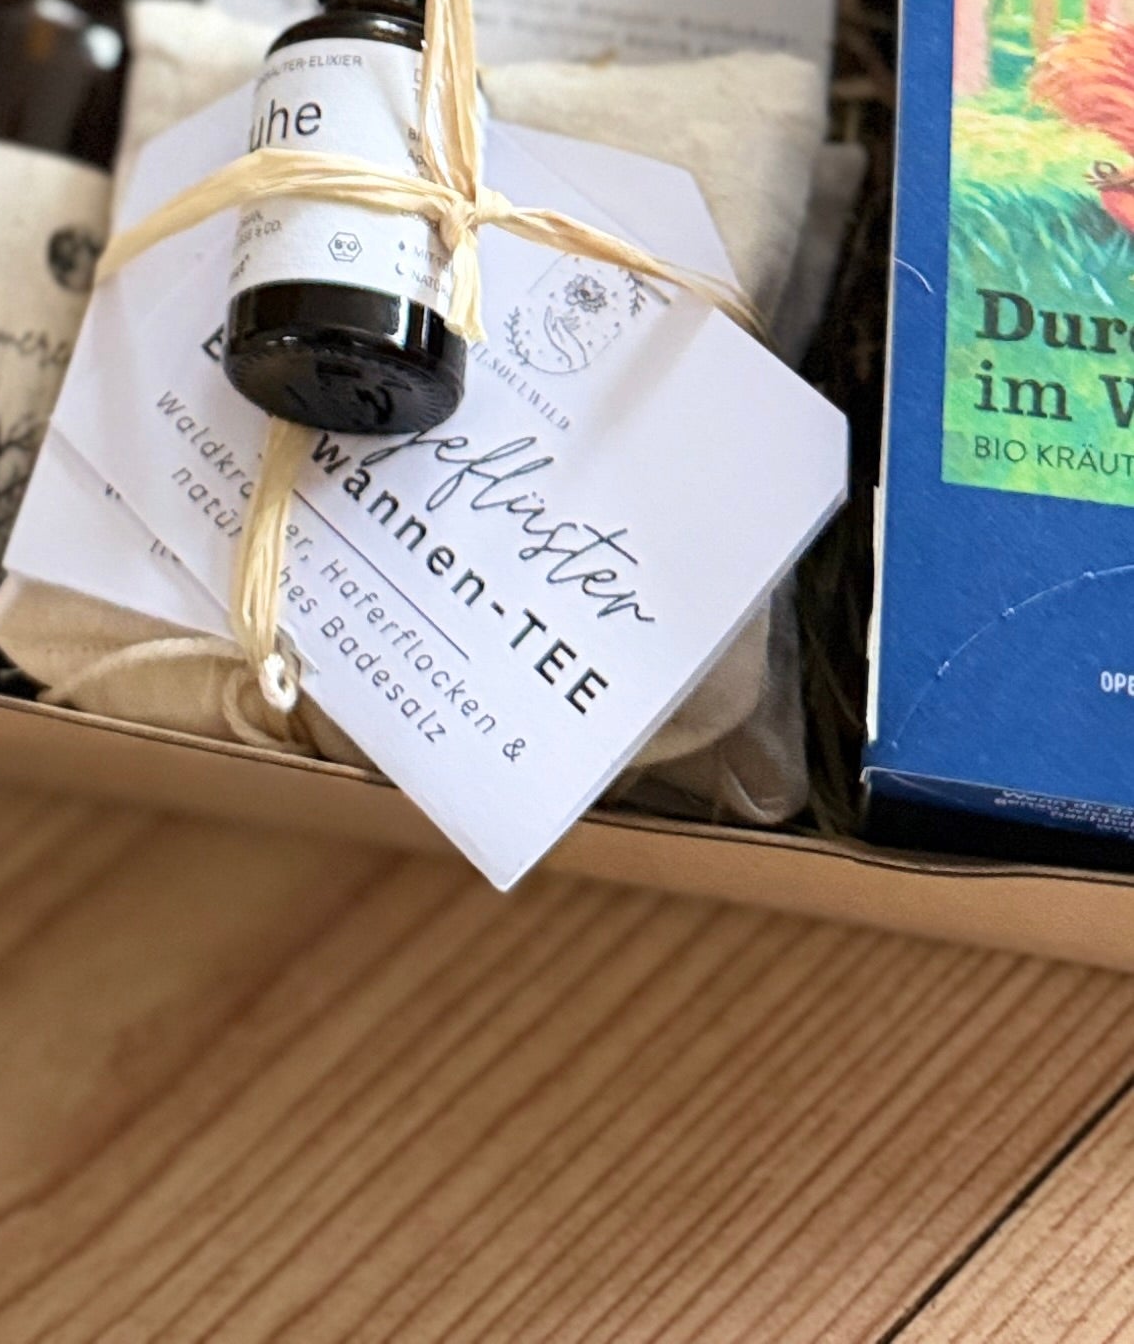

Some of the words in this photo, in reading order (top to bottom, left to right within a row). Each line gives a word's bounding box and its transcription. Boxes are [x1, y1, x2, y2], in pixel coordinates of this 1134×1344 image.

[975, 288, 1134, 355] Dur
[974, 359, 1073, 422] im
[975, 436, 1027, 463] BIO
[320, 559, 497, 715] Haferflocken
[502, 738, 527, 762] &
[321, 615, 447, 744] Badesalz
